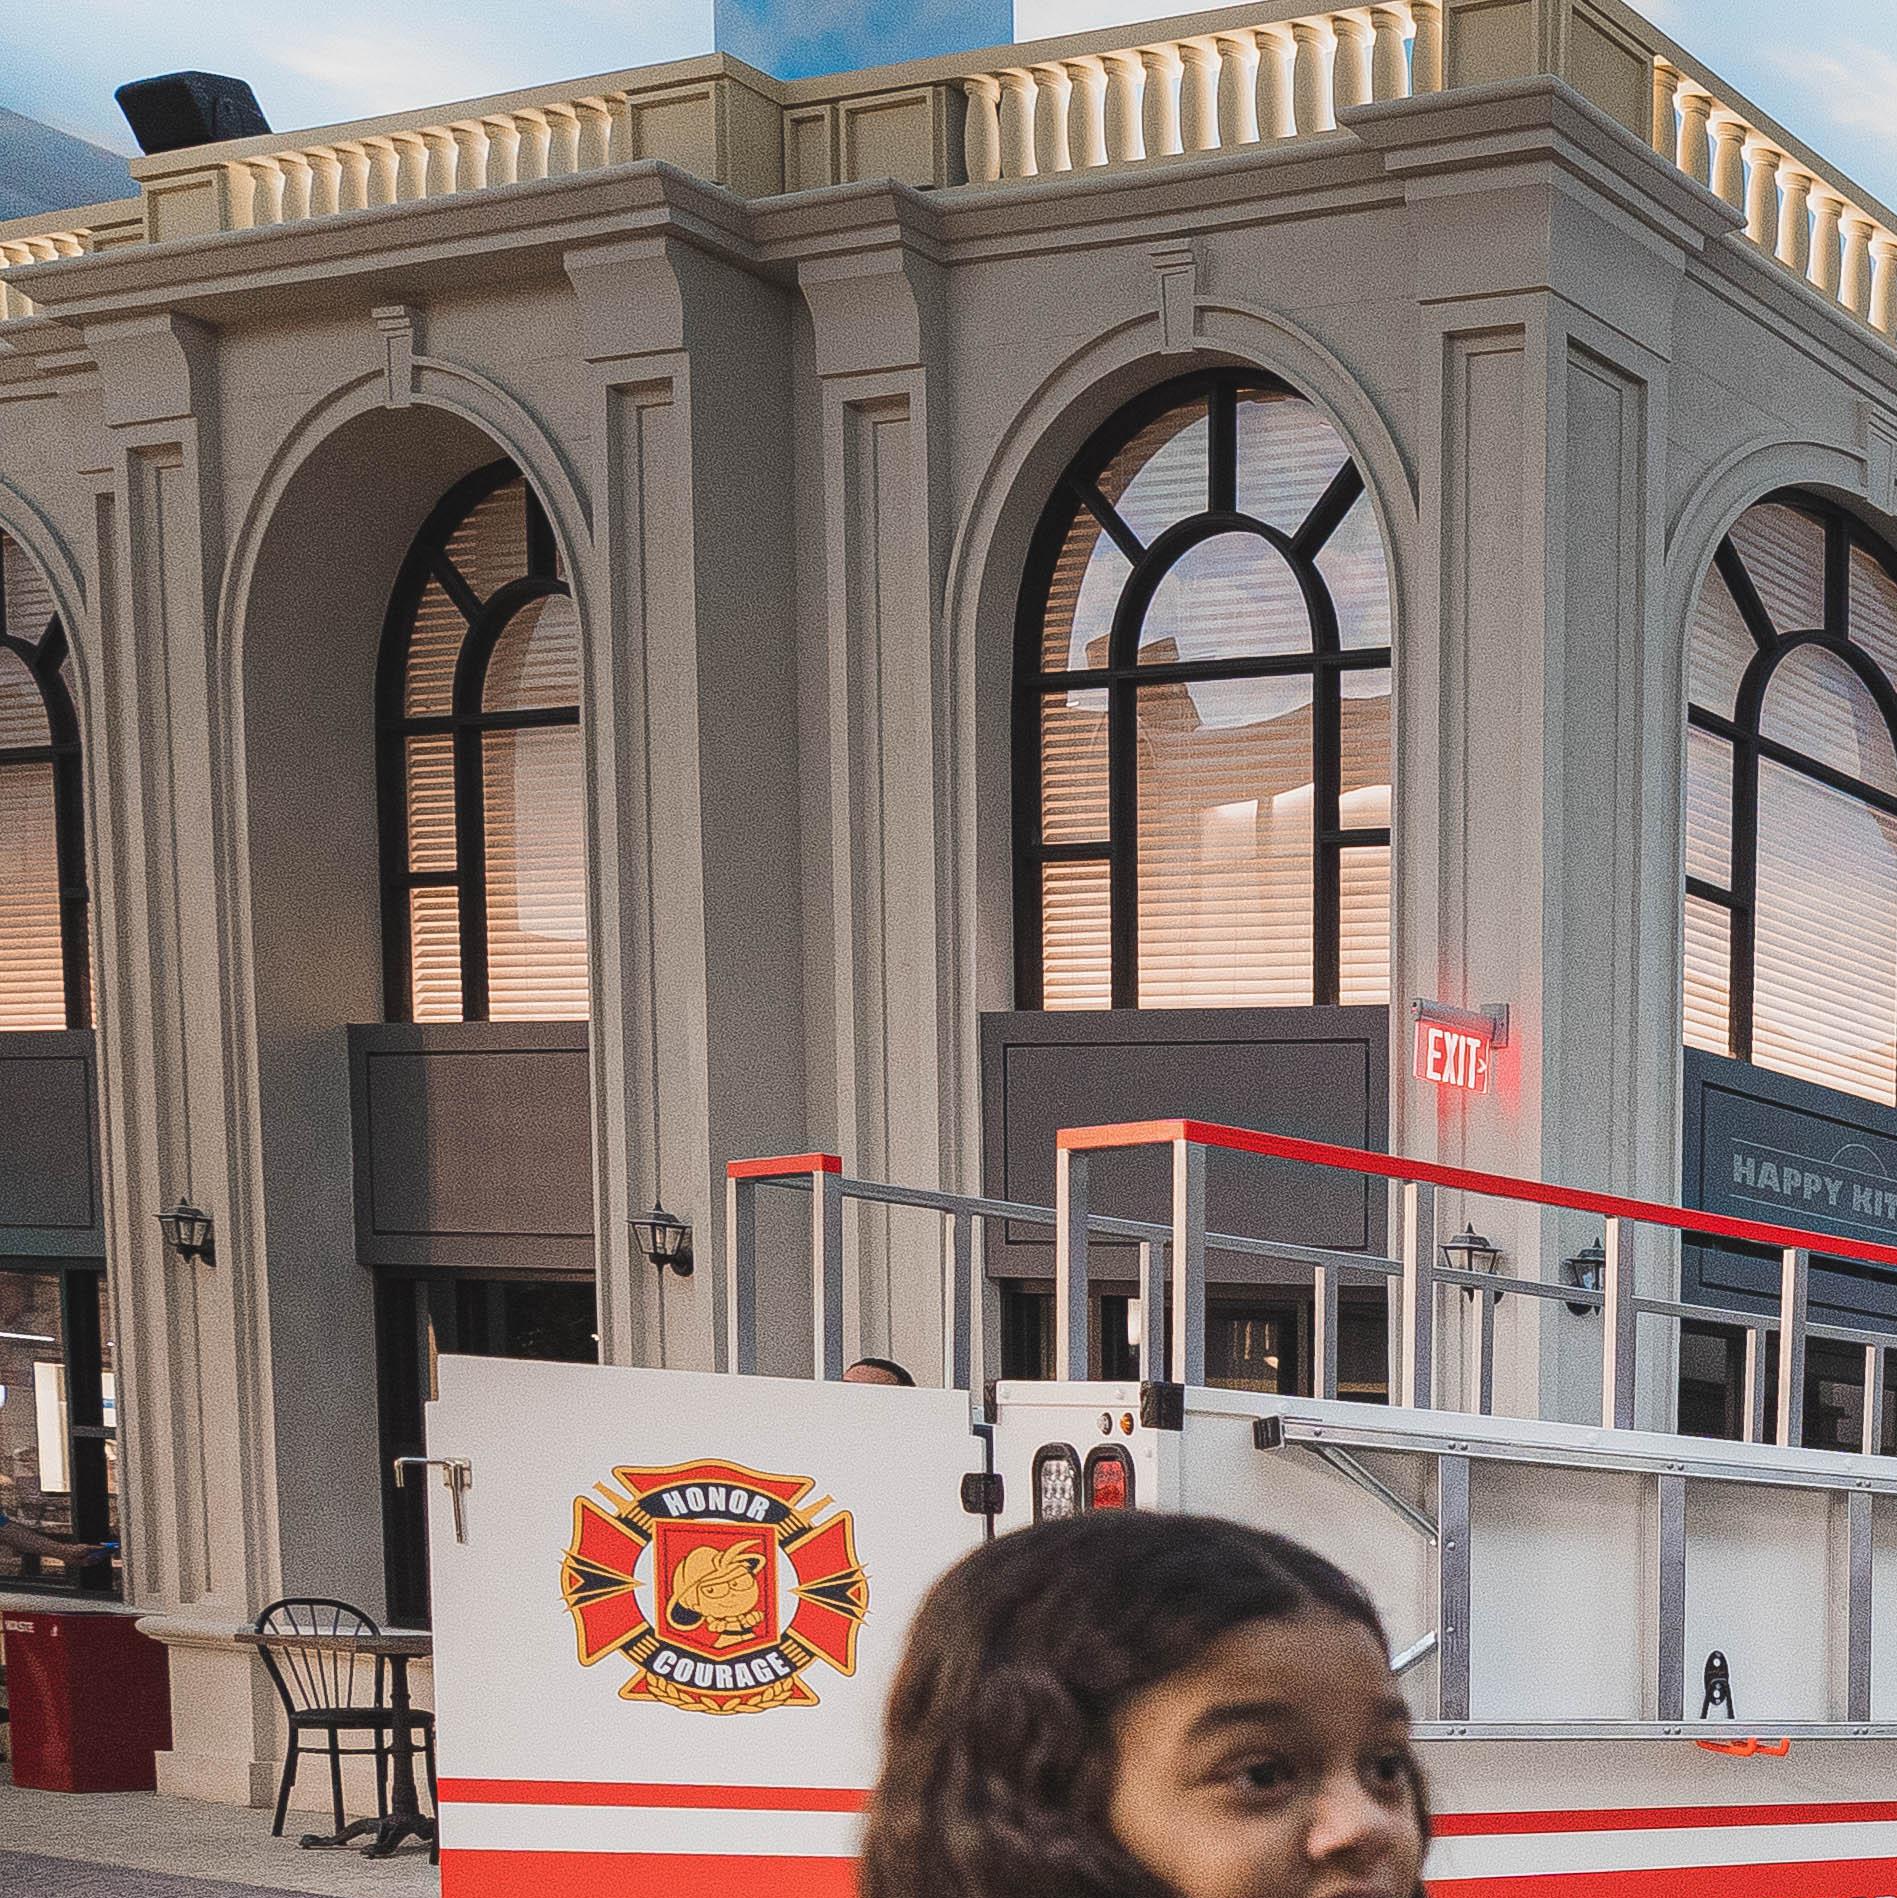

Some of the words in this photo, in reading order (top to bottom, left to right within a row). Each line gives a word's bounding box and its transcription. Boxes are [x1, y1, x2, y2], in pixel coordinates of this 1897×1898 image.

[1426, 1028, 1481, 1089] EXIT
[1732, 1153, 1843, 1205] HAPPY
[662, 1486, 770, 1521] HONOR
[653, 1650, 790, 1688] COURAGE
